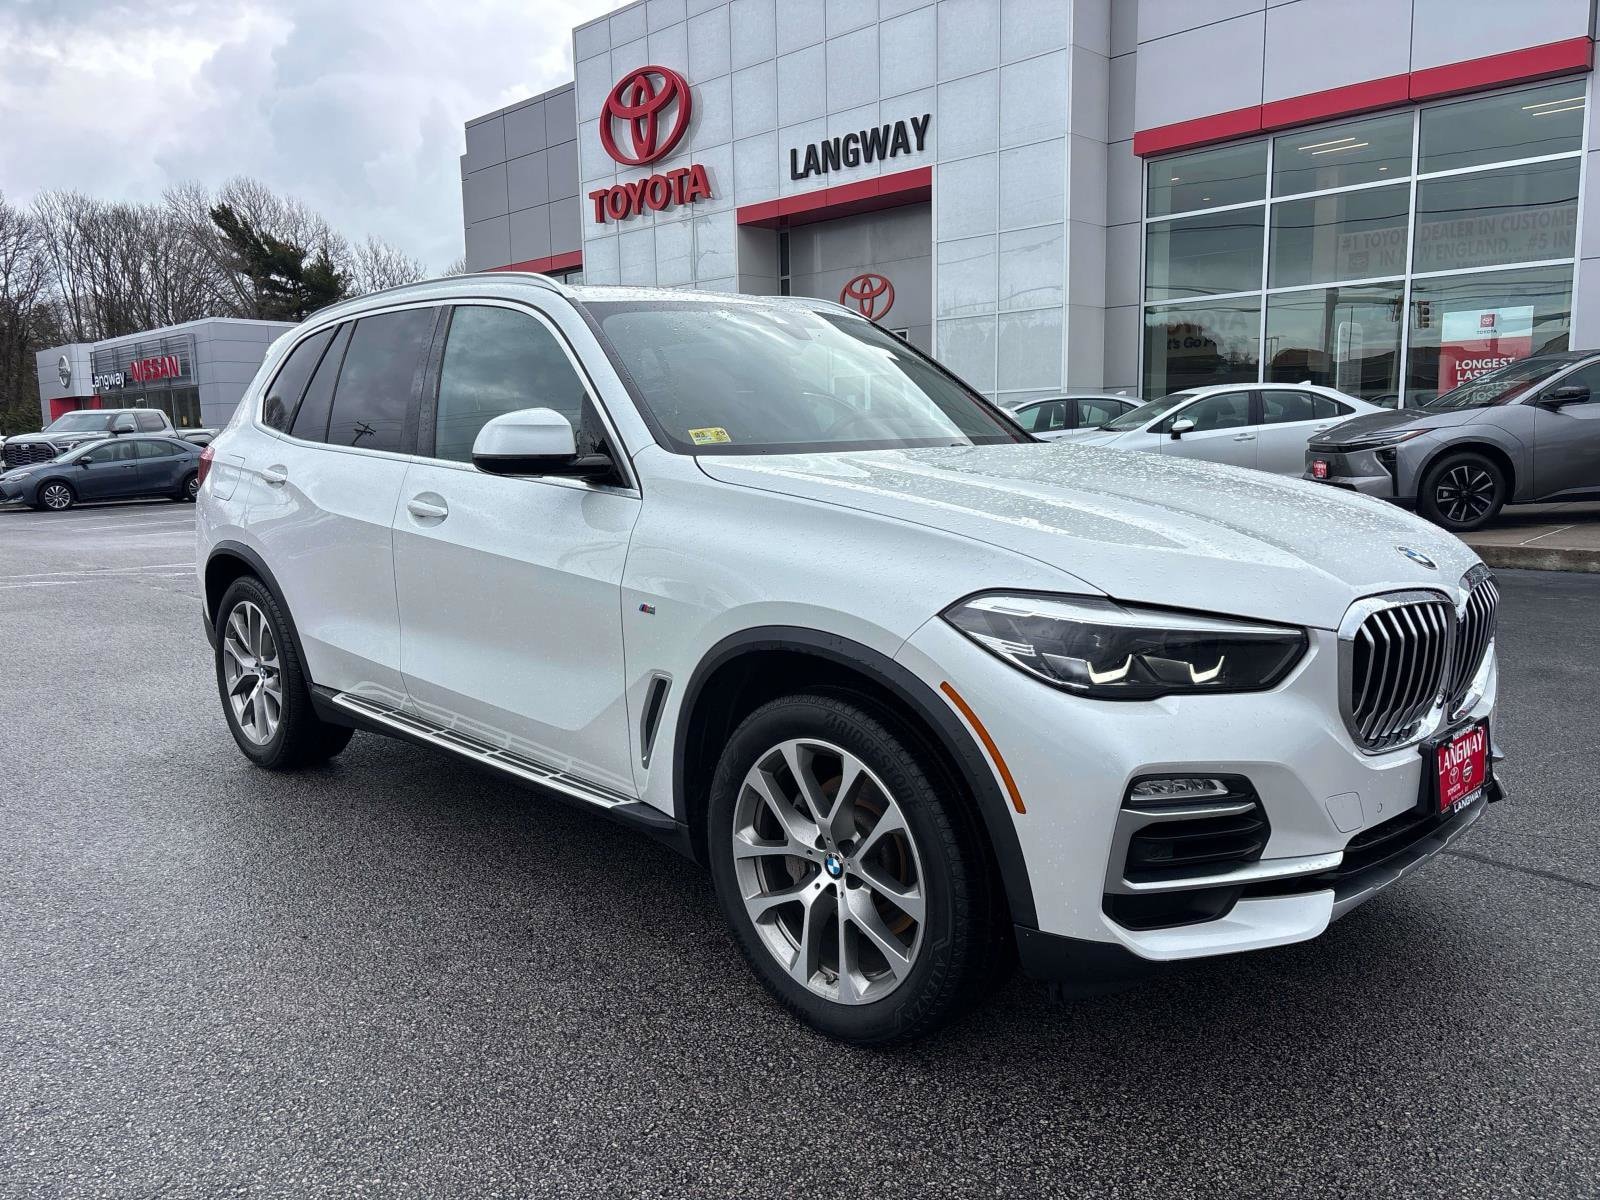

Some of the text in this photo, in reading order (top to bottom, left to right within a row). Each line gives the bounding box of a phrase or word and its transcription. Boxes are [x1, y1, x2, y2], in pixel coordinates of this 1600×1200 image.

[790, 113, 931, 181] LANGWAY
[588, 164, 712, 224] TOYOTA
[1363, 228, 1407, 248] TOYOT
[1421, 219, 1474, 241] DEALER
[1479, 216, 1496, 236] IN
[1501, 207, 1575, 232] CUSTOME
[1380, 249, 1396, 266] IN
[1399, 245, 1431, 264] NW
[1528, 232, 1546, 251] #5
[91, 355, 180, 390] Langway NISSAN
[1455, 357, 1515, 370] LONGEST
[1438, 732, 1484, 775] LANGWAY
[1453, 789, 1482, 813] LANGWAY
